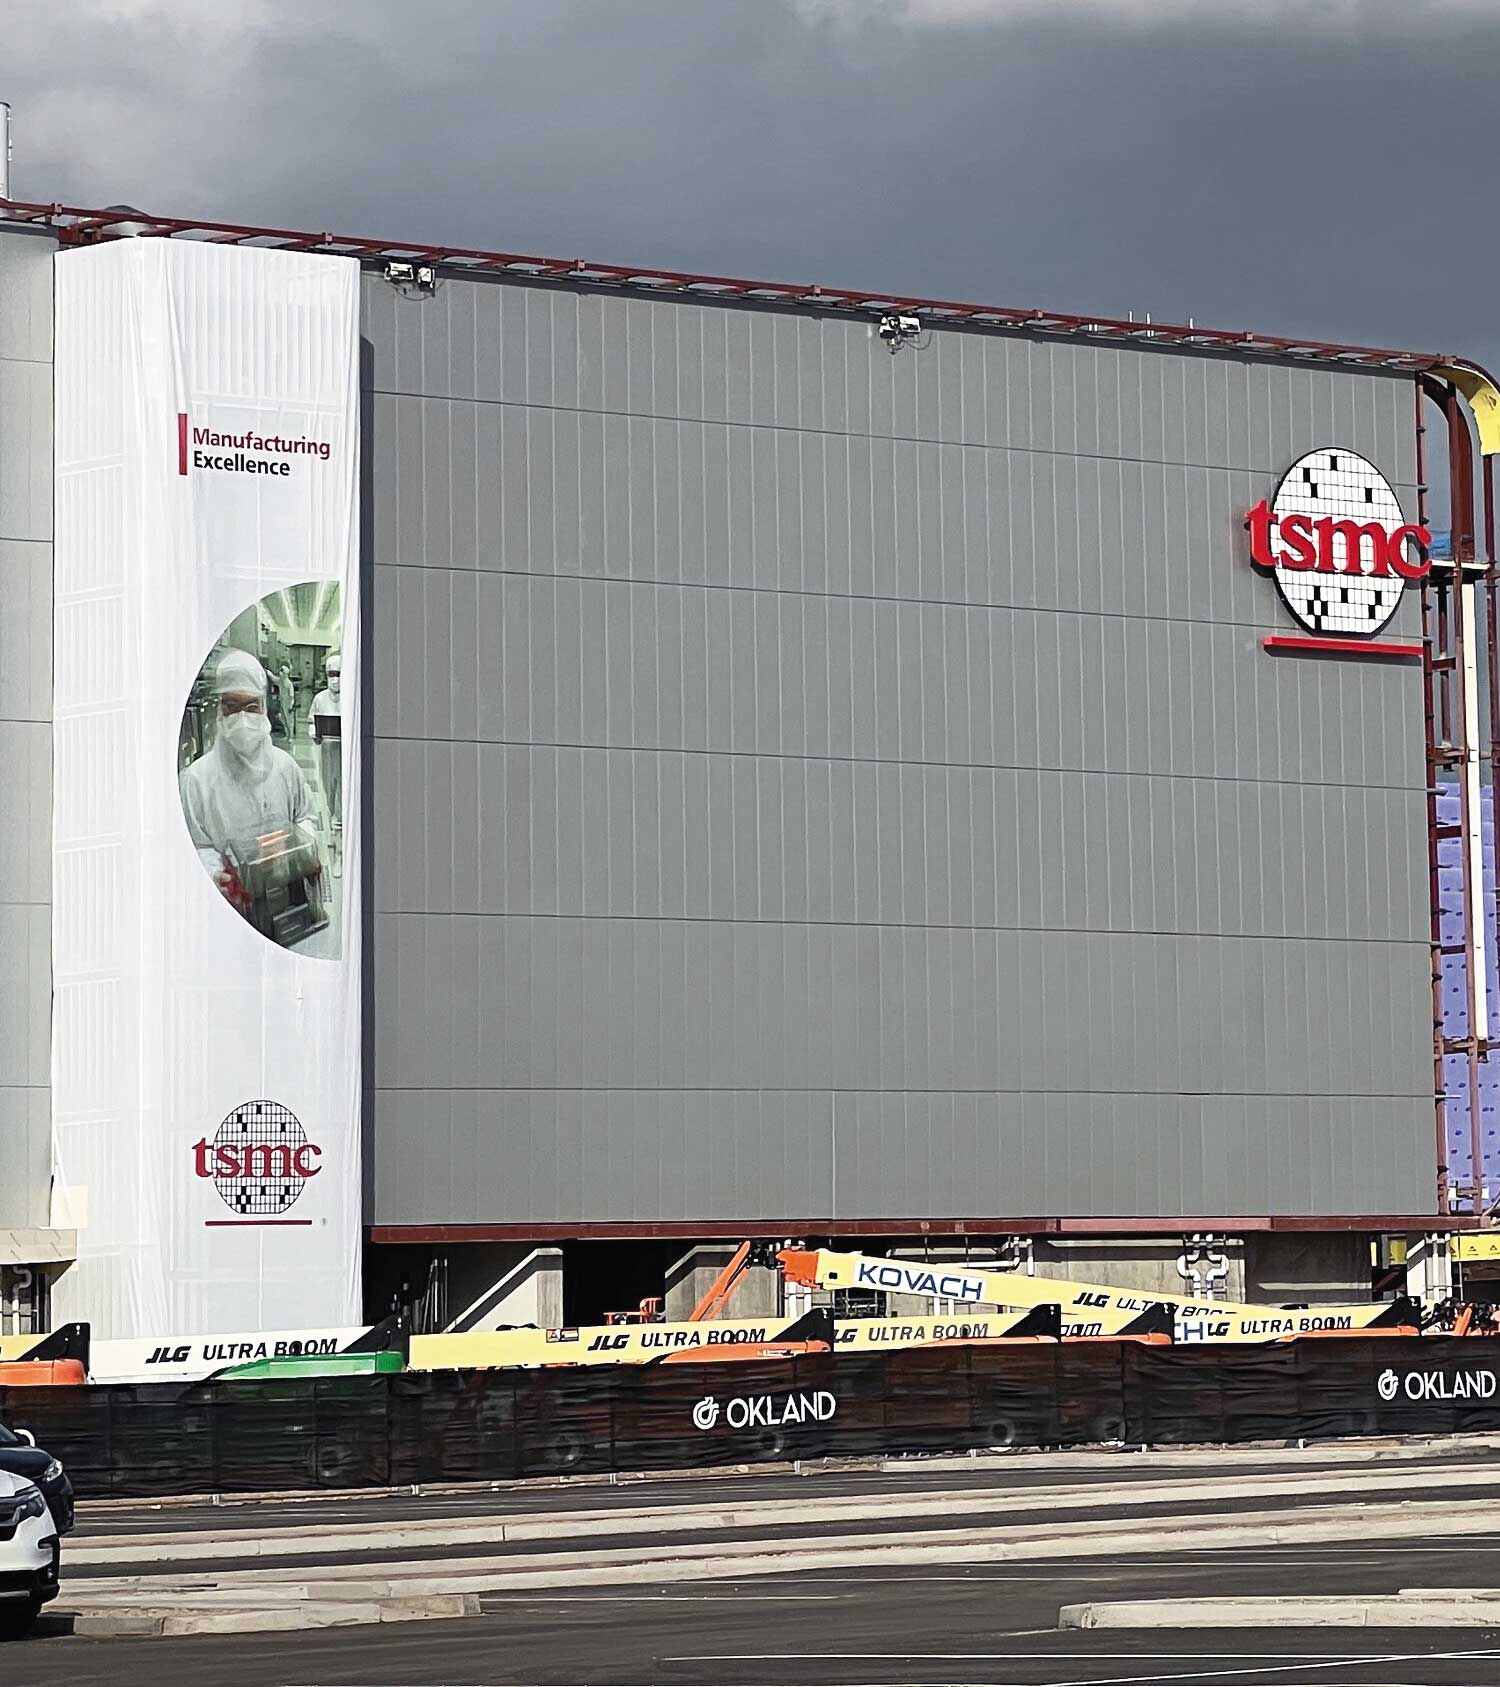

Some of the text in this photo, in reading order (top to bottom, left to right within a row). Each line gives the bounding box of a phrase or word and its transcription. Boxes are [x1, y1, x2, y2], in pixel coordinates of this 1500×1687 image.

[193, 427, 331, 460] Manufacturing
[193, 451, 291, 476] Excellence
[1245, 498, 1433, 580] tsmc
[192, 1138, 323, 1178] tsmc
[858, 1263, 983, 1300] KOVACH
[1072, 1292, 1110, 1308] JLG
[868, 1324, 925, 1341] ULTRA
[932, 1323, 988, 1339] BOOM
[1241, 1318, 1294, 1335] ULTRA
[1299, 1315, 1351, 1332] BOOM
[145, 1338, 338, 1364] JLG ULTRA BOOM
[587, 1328, 766, 1351] JLG ULTRA BOOM
[1404, 1370, 1497, 1400] OKLAND
[726, 1391, 836, 1428] OKLAND
